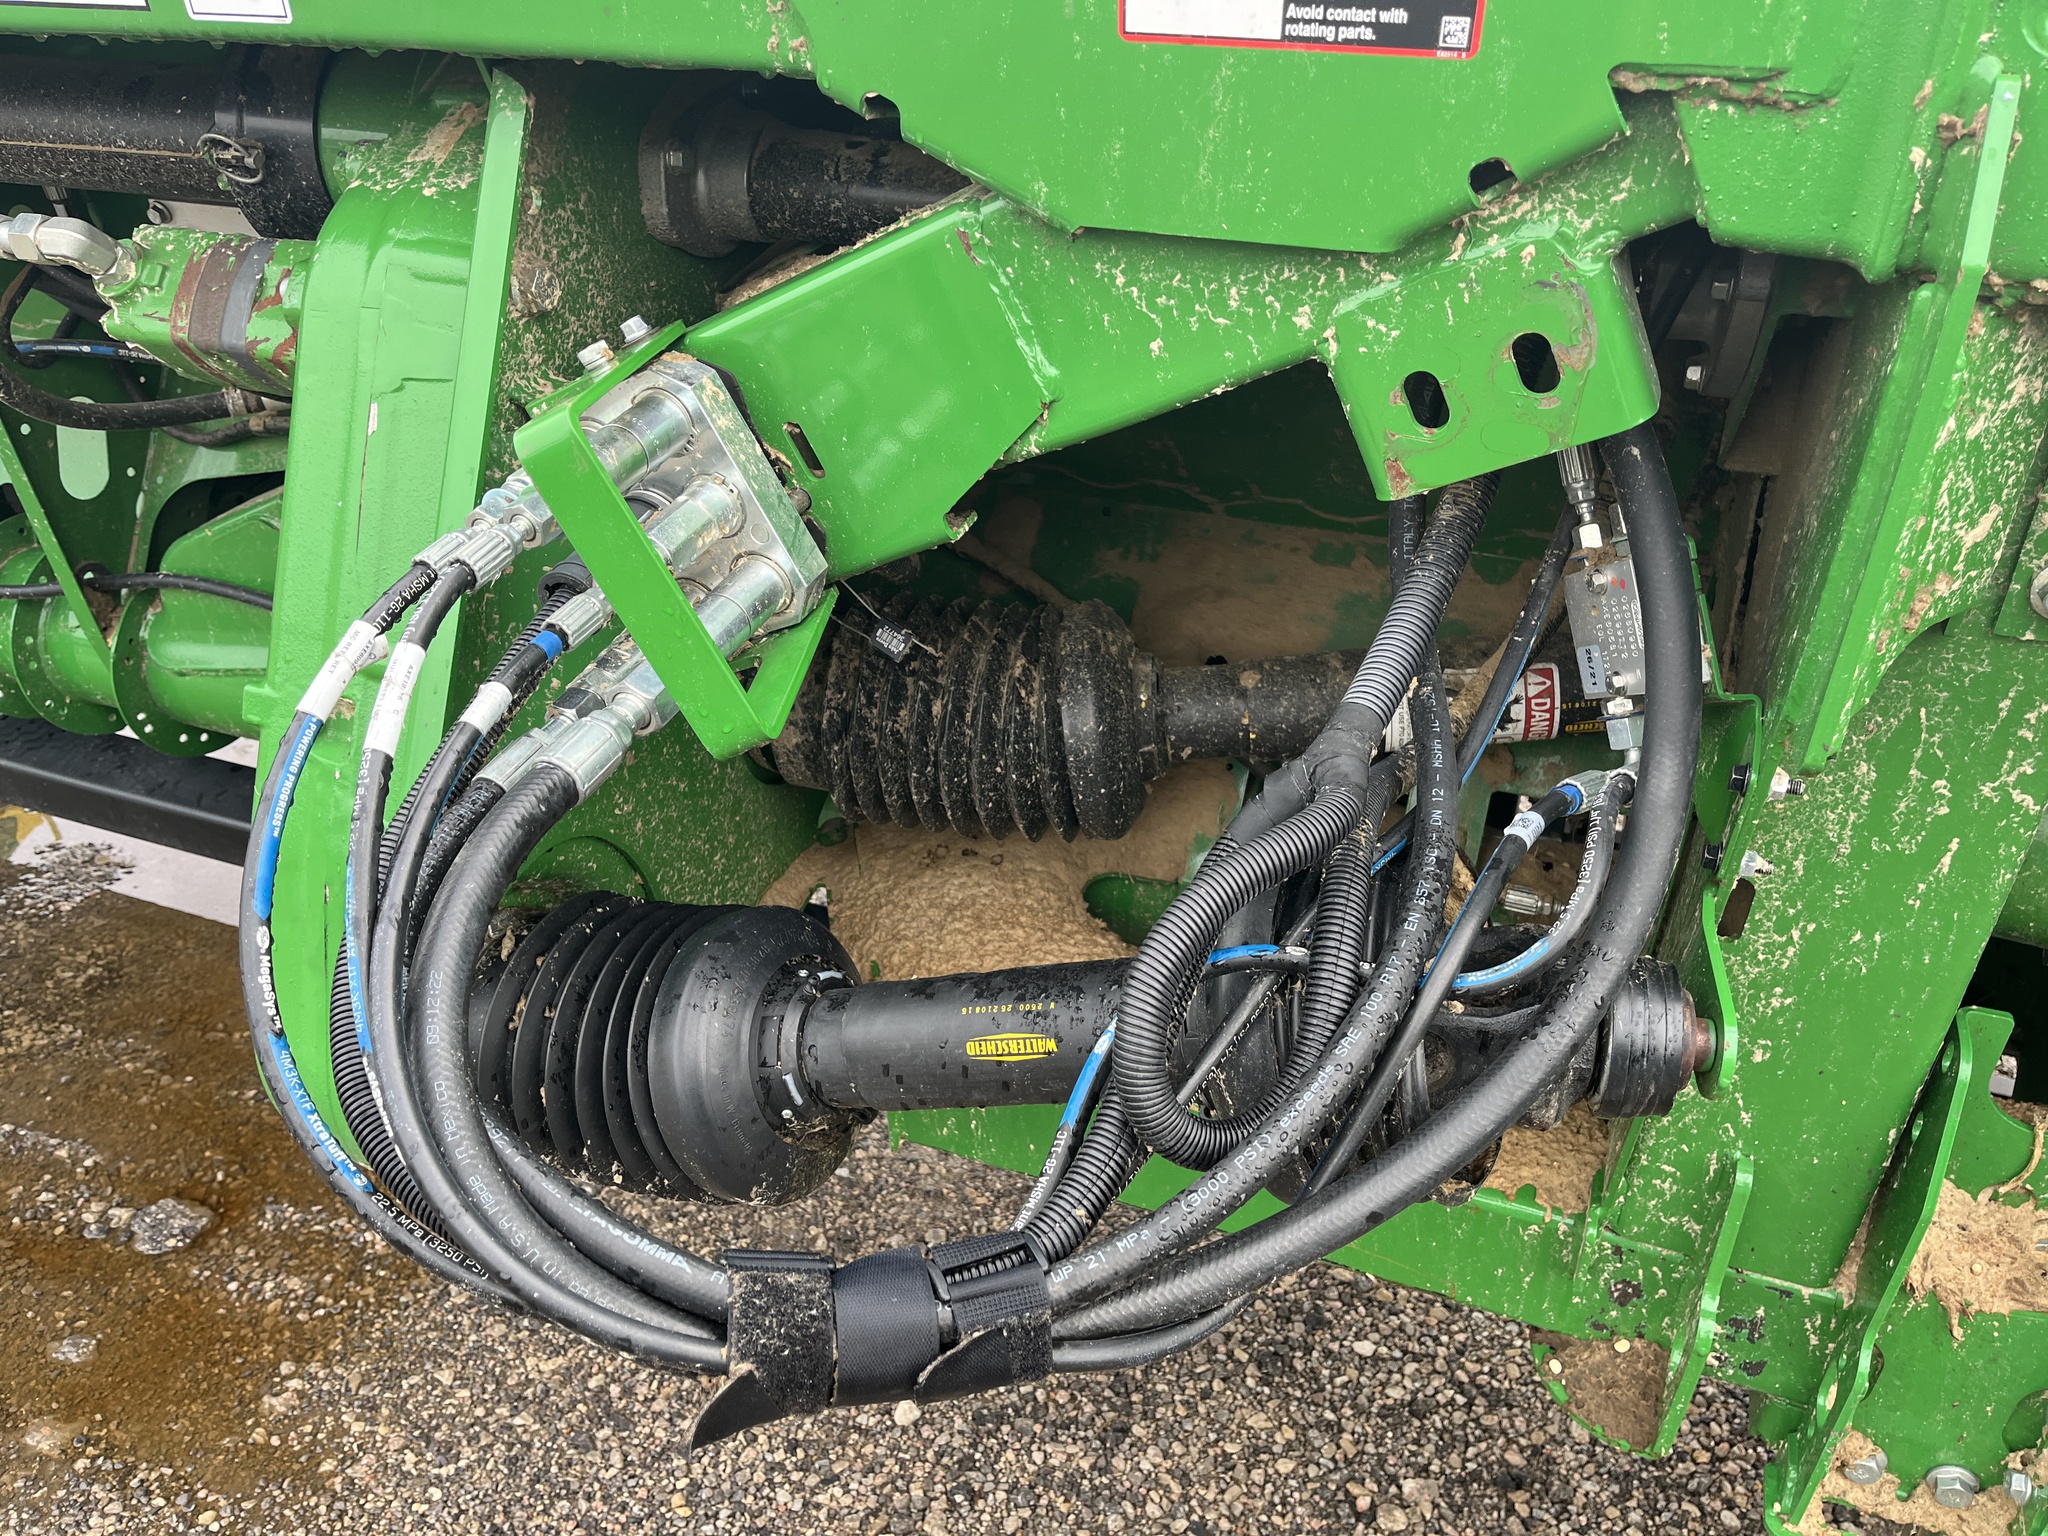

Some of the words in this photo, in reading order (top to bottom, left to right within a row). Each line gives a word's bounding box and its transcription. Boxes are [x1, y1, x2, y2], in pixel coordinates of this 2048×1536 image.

[1286, 4, 1324, 20] Avoid
[1326, 6, 1377, 23] contact
[1379, 8, 1409, 24] with
[1285, 23, 1335, 41] rotating
[1337, 25, 1376, 41] parts.
[1403, 519, 1413, 559] ITALY
[402, 572, 431, 601] MSHA
[1584, 647, 1598, 687] 26/21
[289, 722, 317, 773] POWERING
[1431, 739, 1443, 767] MSHA
[1432, 787, 1444, 803] 12
[1430, 808, 1443, 827] DN
[1413, 880, 1432, 906] 857
[1403, 912, 1422, 932] EN
[1548, 911, 1571, 937] 22.5
[1567, 887, 1584, 911] MPa
[1380, 955, 1402, 985] R17
[1019, 1003, 1042, 1011] 2500
[1360, 992, 1383, 1020] 100
[965, 1038, 1058, 1056] WALTERSCHEID
[1336, 1026, 1362, 1057] SAE
[278, 1049, 315, 1110] 4M3K-XTF
[1279, 1062, 1336, 1128] exceeds
[433, 1081, 459, 1141] Mexico
[458, 1145, 470, 1165] in
[1233, 1132, 1272, 1171] PSI)
[1026, 1173, 1050, 1210] MSHA
[1042, 1129, 1068, 1175] 2G-11C
[469, 1176, 500, 1213] Made
[1180, 1170, 1230, 1216] (3000
[370, 1191, 400, 1218] 22.5
[396, 1212, 426, 1239] MPa
[423, 1232, 464, 1264] (3250
[1115, 1226, 1152, 1252] MPa
[1050, 1263, 1075, 1285] WP
[1087, 1250, 1109, 1269] 21
